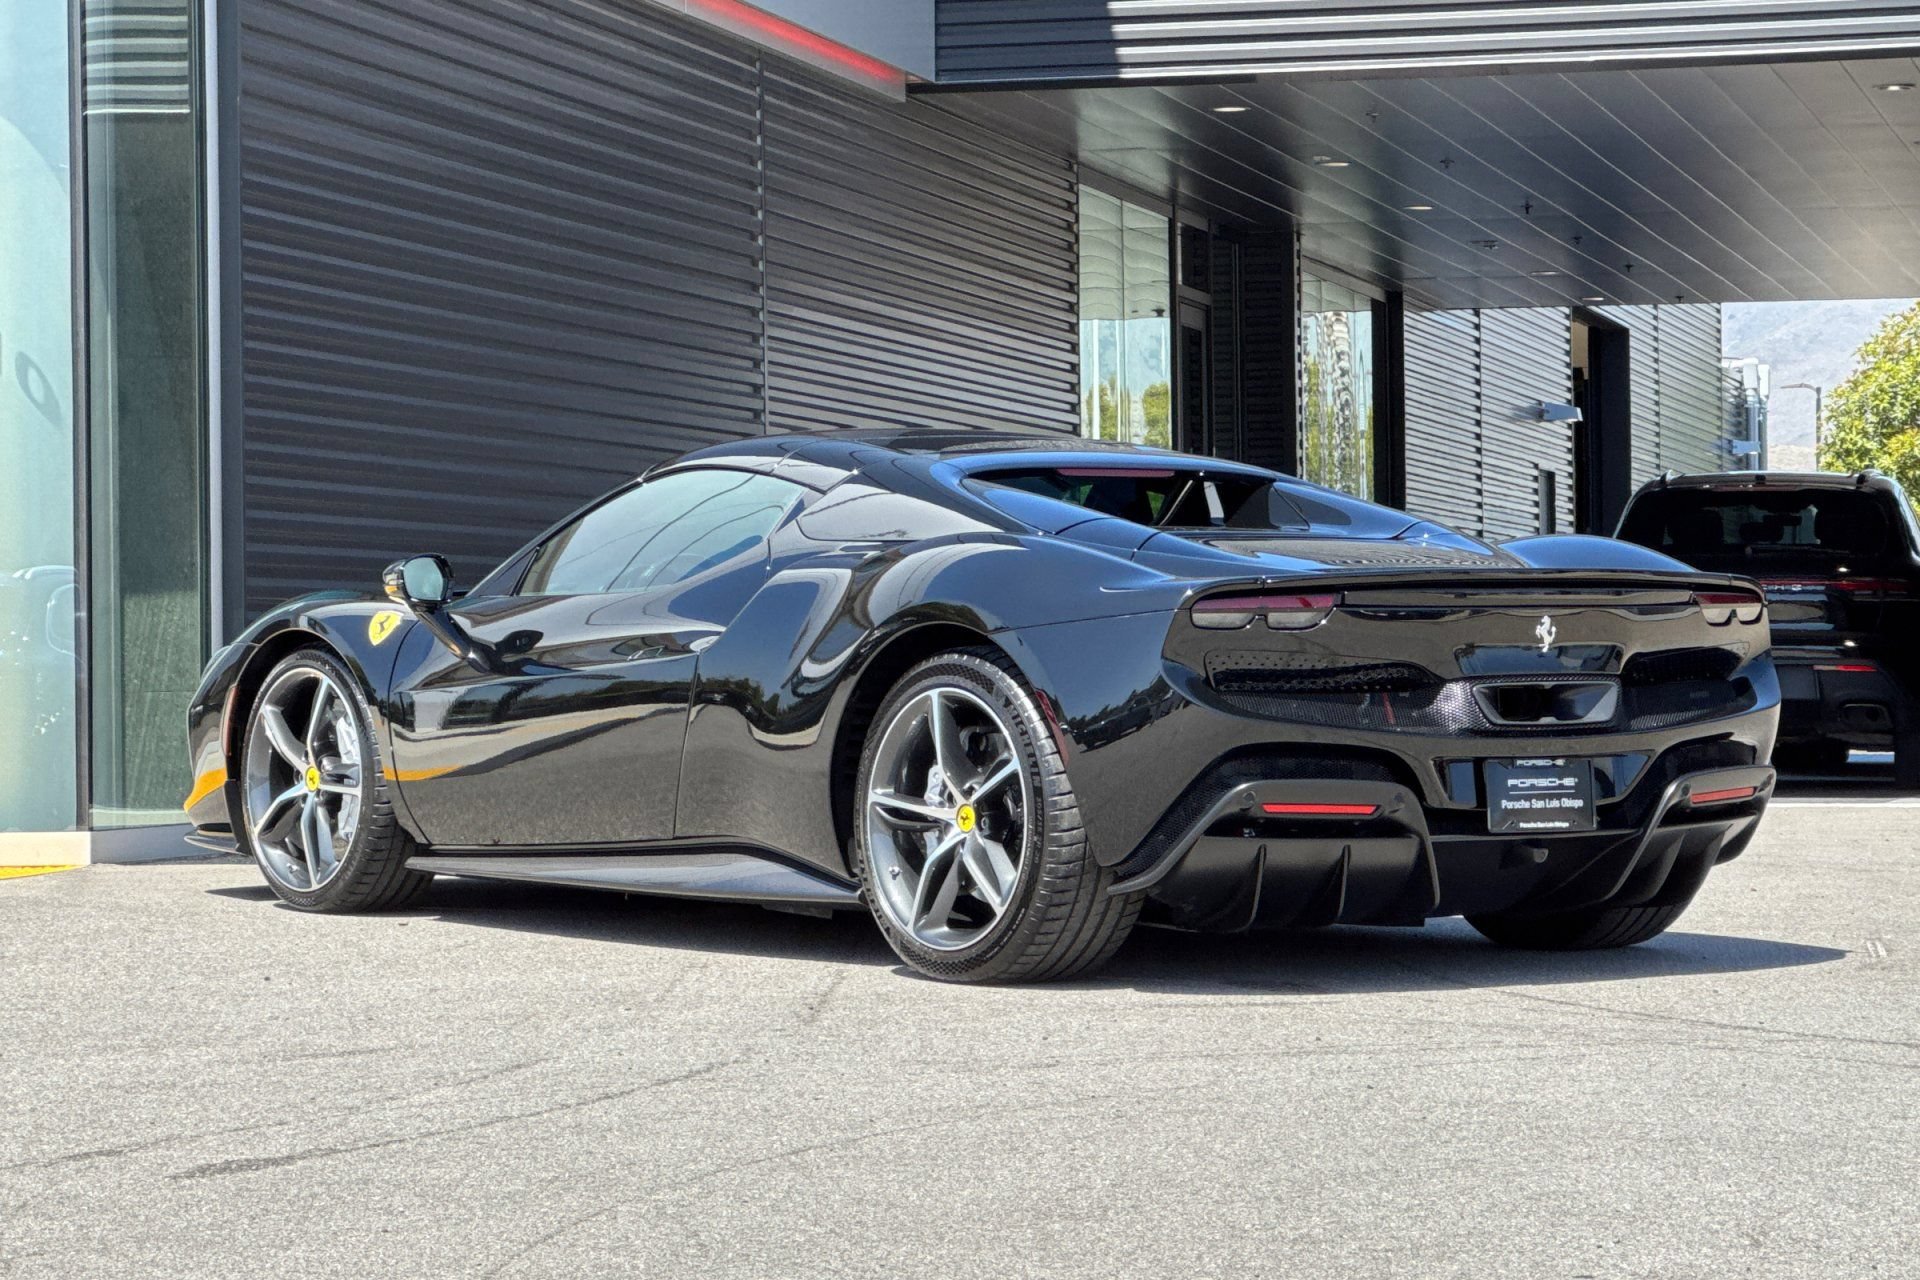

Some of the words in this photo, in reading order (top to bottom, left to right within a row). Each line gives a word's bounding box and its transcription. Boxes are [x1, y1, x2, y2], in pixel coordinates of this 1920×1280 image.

[1501, 799, 1530, 809] Porsche
[1531, 799, 1545, 809] San
[1545, 798, 1561, 808] Luis
[1561, 797, 1584, 809] Obispo
